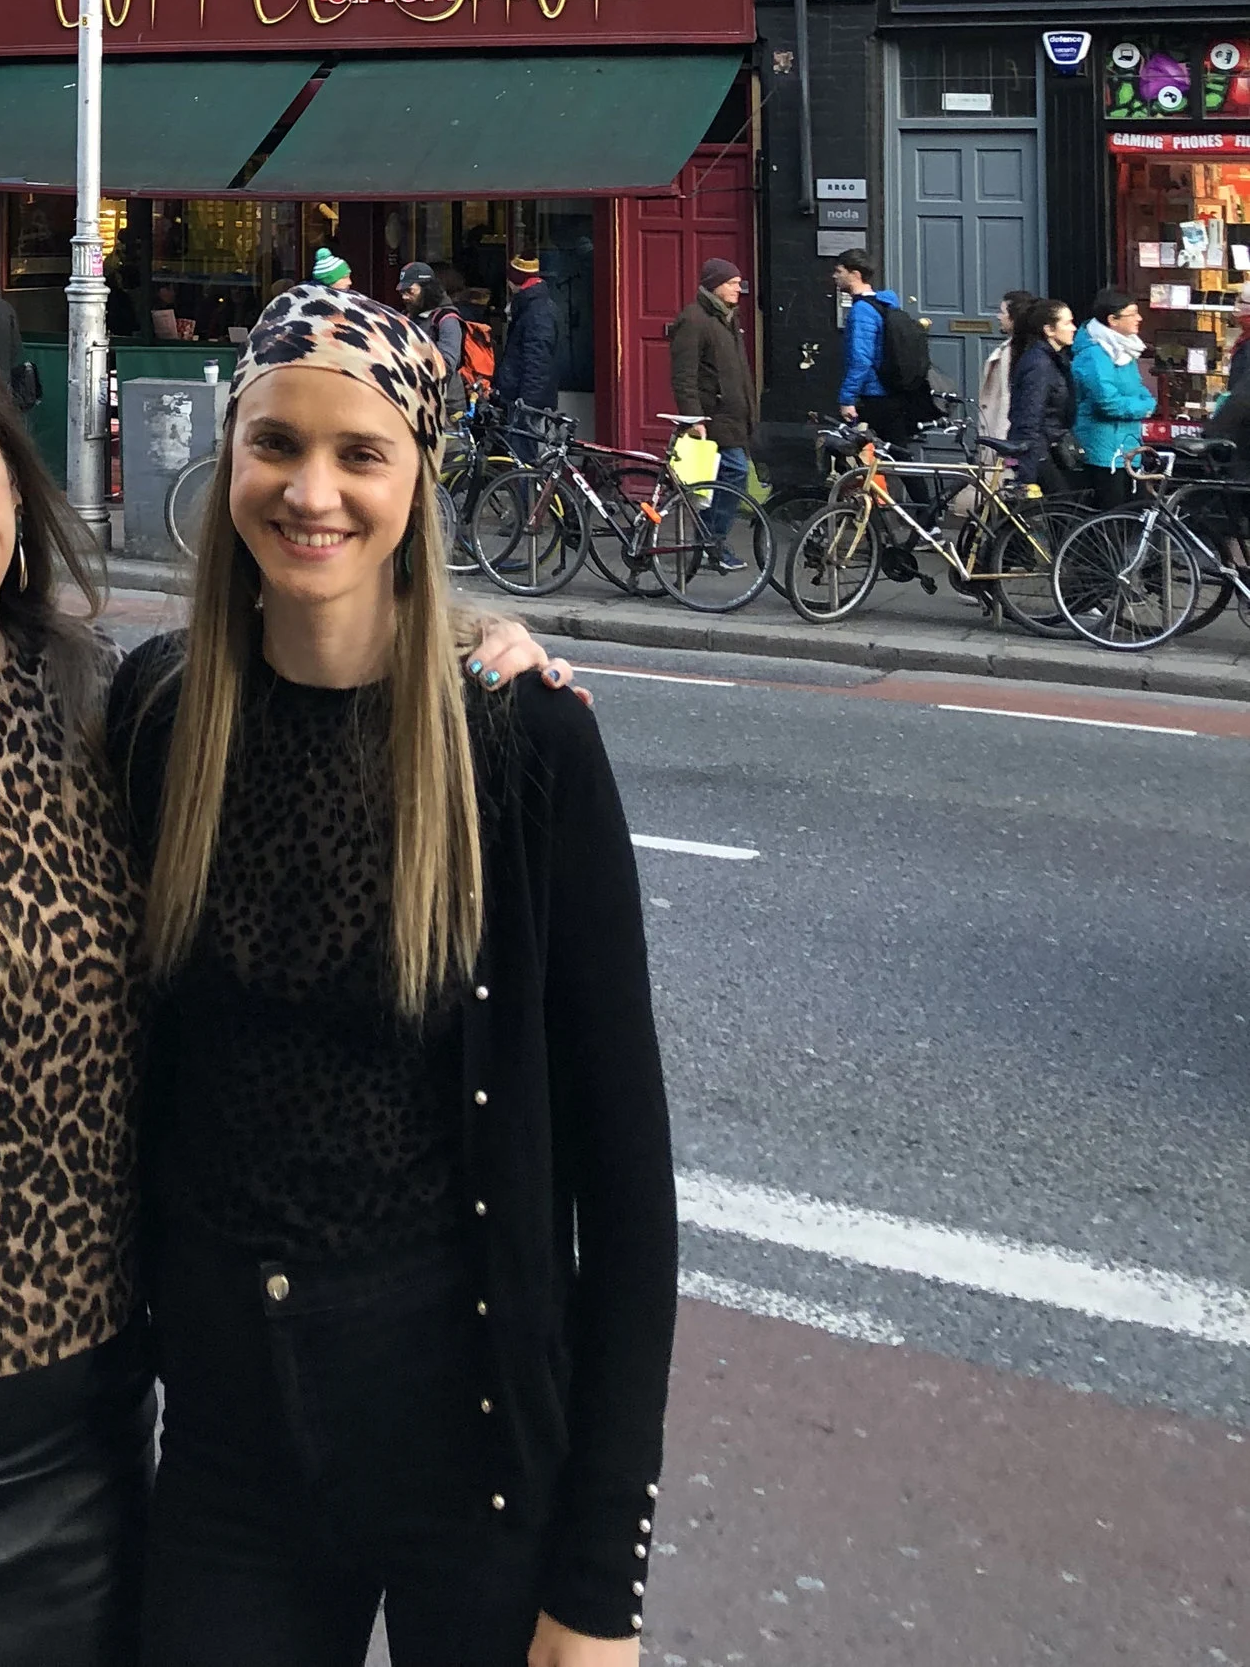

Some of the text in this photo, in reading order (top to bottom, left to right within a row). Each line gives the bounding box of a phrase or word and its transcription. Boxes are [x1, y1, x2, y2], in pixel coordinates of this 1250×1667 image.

[1049, 35, 1082, 43] defence
[1113, 133, 1163, 149] GAMING
[1172, 134, 1223, 149] PHONES
[827, 208, 859, 219] noda
